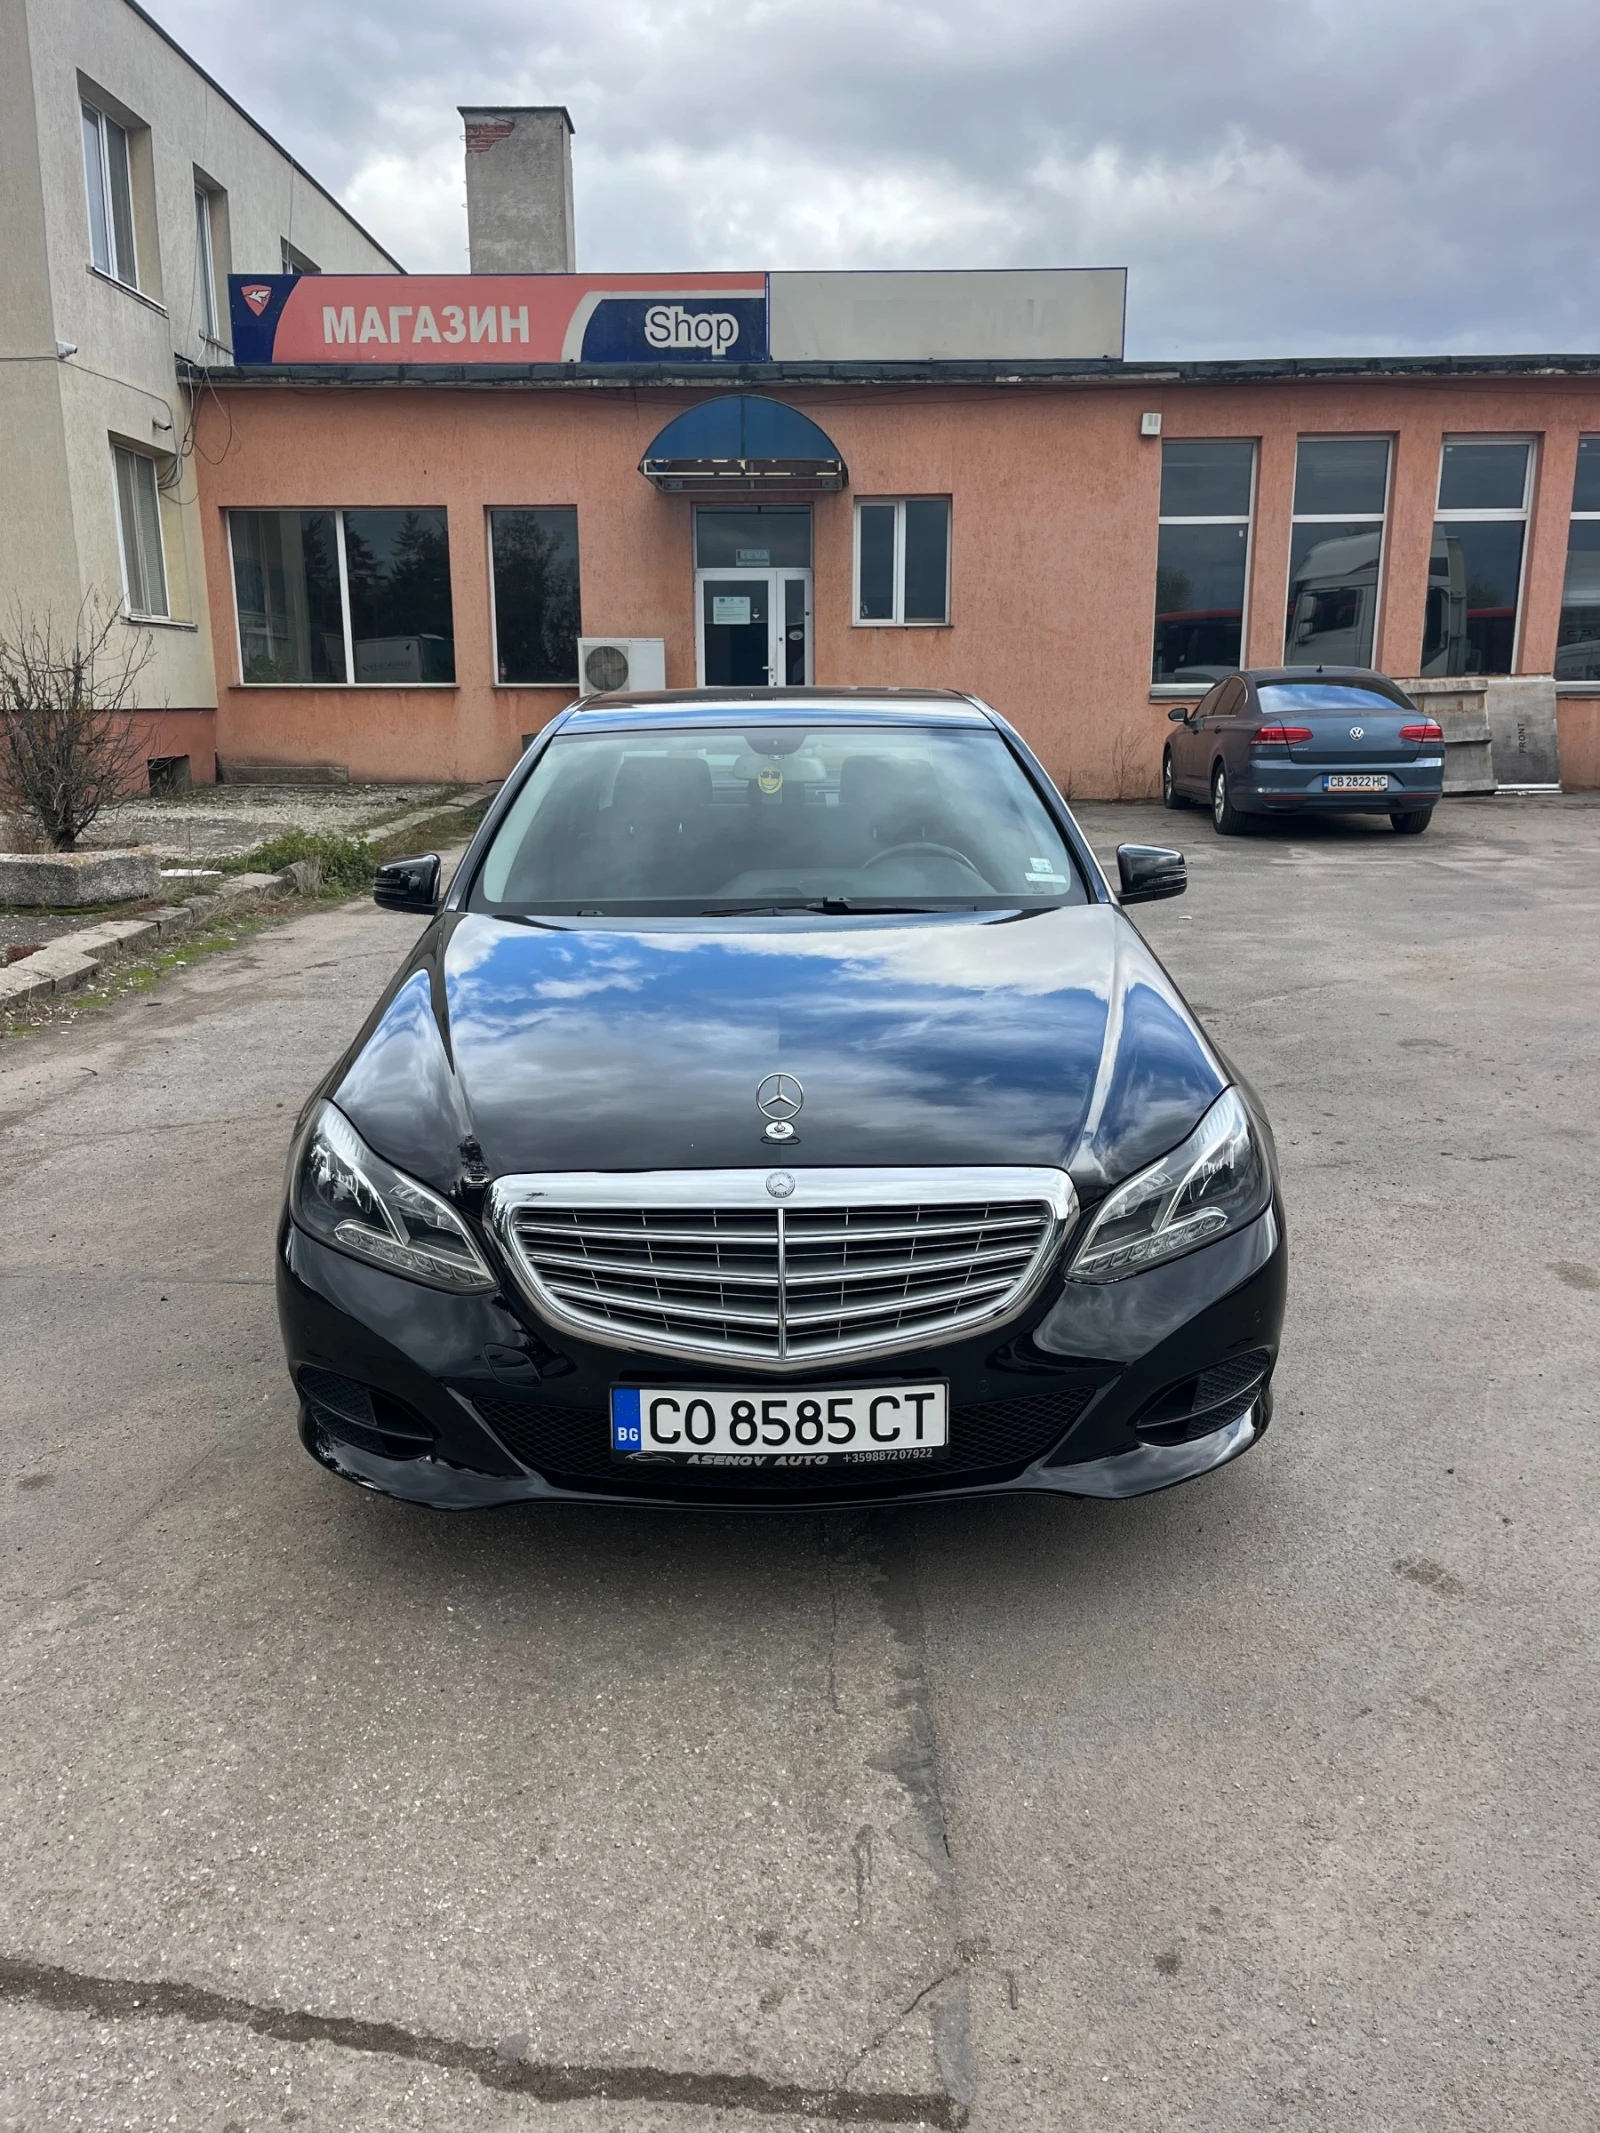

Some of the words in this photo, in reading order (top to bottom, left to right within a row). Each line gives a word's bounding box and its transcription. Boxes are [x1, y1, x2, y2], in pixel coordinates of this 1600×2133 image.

[322, 305, 530, 344] МАГАЗИН
[644, 306, 739, 354] Shop
[1517, 722, 1527, 754] FRONT
[1330, 776, 1344, 787] CB
[1346, 776, 1371, 787] 2822
[1372, 776, 1387, 787] HC
[649, 1397, 716, 1446] CO
[729, 1397, 856, 1446] 8585
[869, 1391, 935, 1444] CT
[617, 1427, 639, 1442] BG
[687, 1454, 767, 1467] ASENOV
[774, 1454, 829, 1466] AUTO
[842, 1447, 933, 1463] +359887207922
